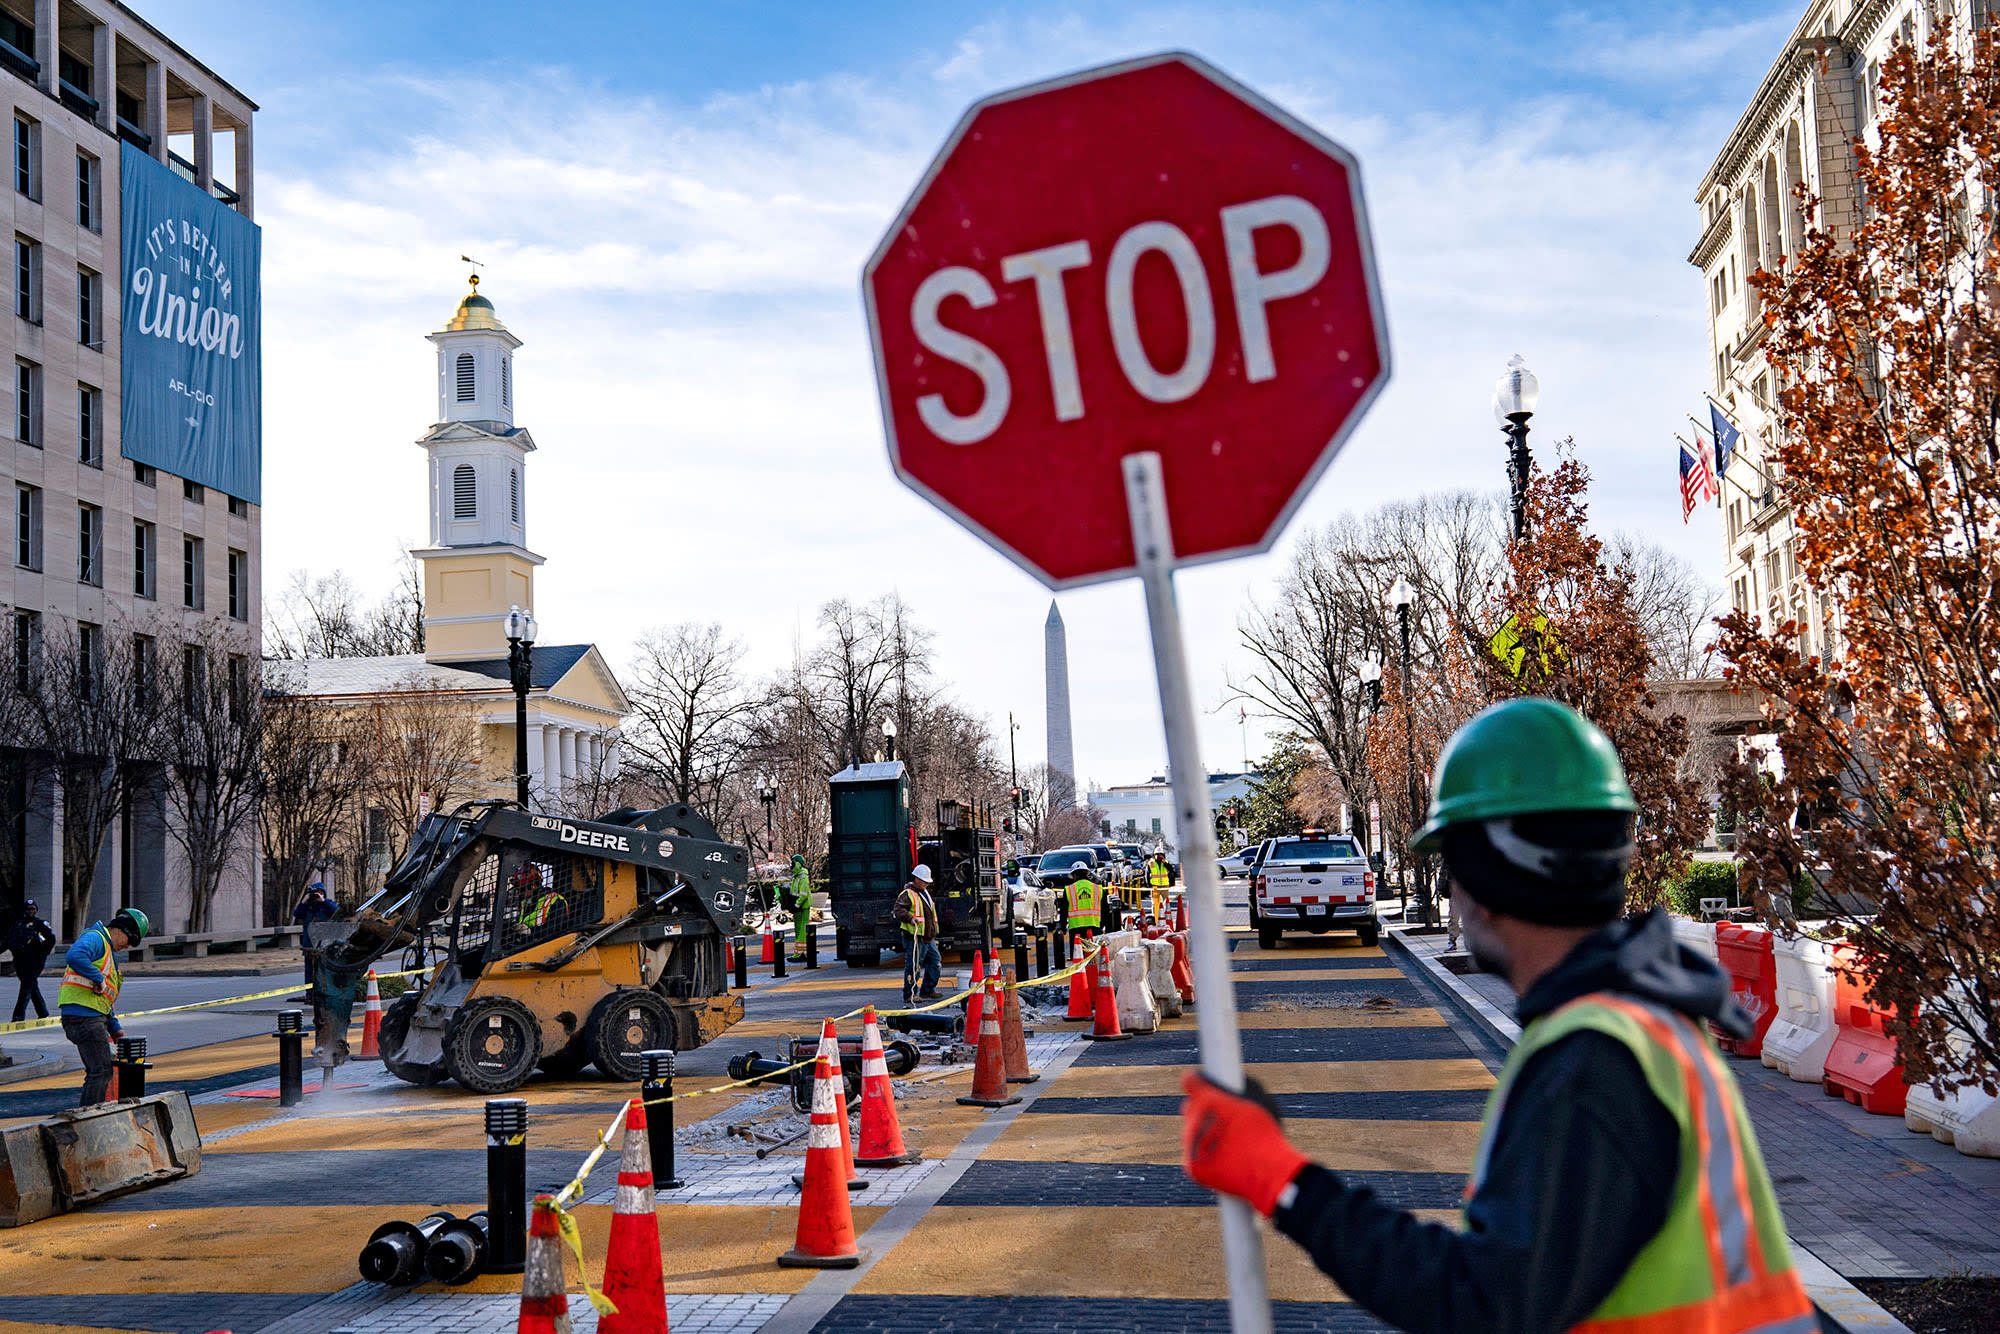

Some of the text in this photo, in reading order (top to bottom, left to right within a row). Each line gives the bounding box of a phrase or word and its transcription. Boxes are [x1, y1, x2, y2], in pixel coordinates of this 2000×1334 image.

[146, 218, 232, 301] IT'S BETTER
[180, 255, 202, 281] IN A
[133, 266, 245, 360] Union
[911, 194, 1332, 446] STOP
[168, 378, 215, 407] AFL-CIO
[560, 824, 630, 852] DEERE
[1273, 876, 1304, 885] Dewberry
